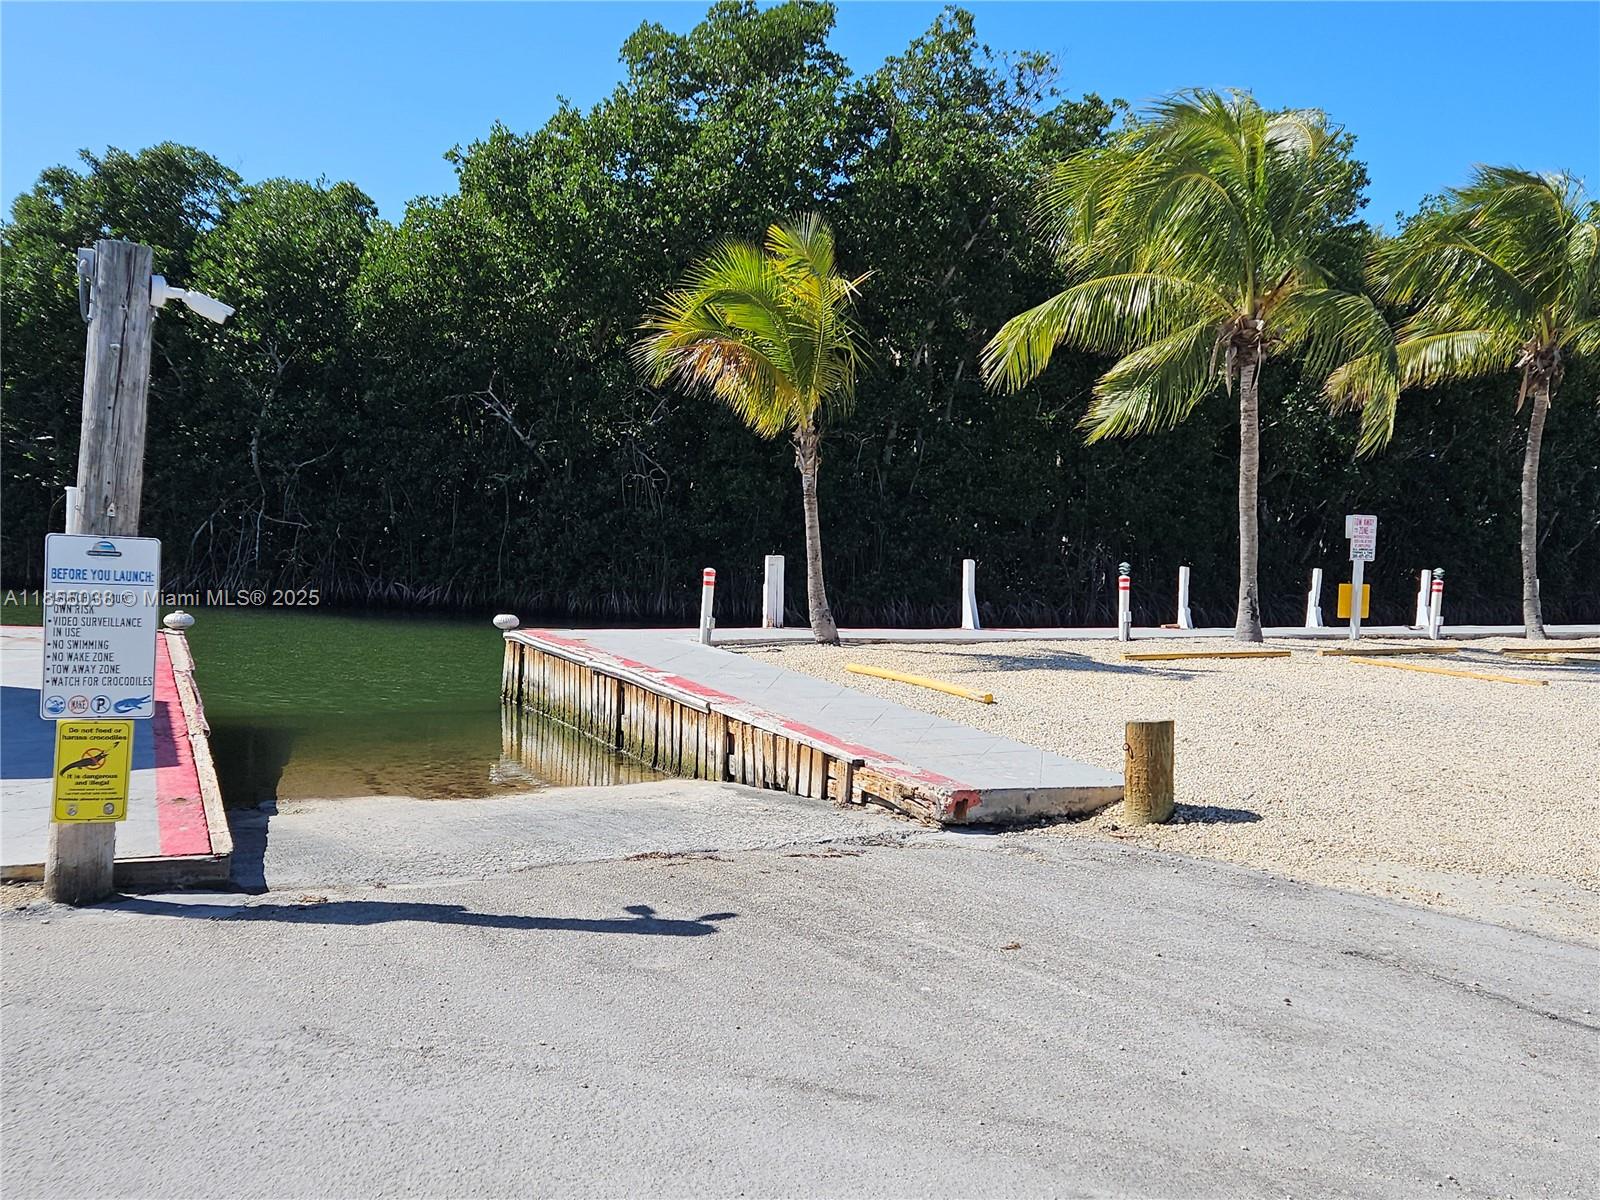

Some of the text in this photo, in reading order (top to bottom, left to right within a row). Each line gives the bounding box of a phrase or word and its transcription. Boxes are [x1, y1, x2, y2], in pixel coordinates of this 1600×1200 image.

[51, 567, 154, 583] BEFORE YOU LAUNCH:
[53, 603, 94, 614] OWN RISK
[53, 616, 142, 627] VIDEO SURVEILLANCE
[53, 627, 81, 637] IN USE
[52, 640, 109, 650] NO SWIMMING
[51, 652, 115, 662] NO WAKE ZONE
[51, 664, 121, 674] TOW AWAY ZONE
[51, 676, 152, 687] WATCH FOR CROCODILES
